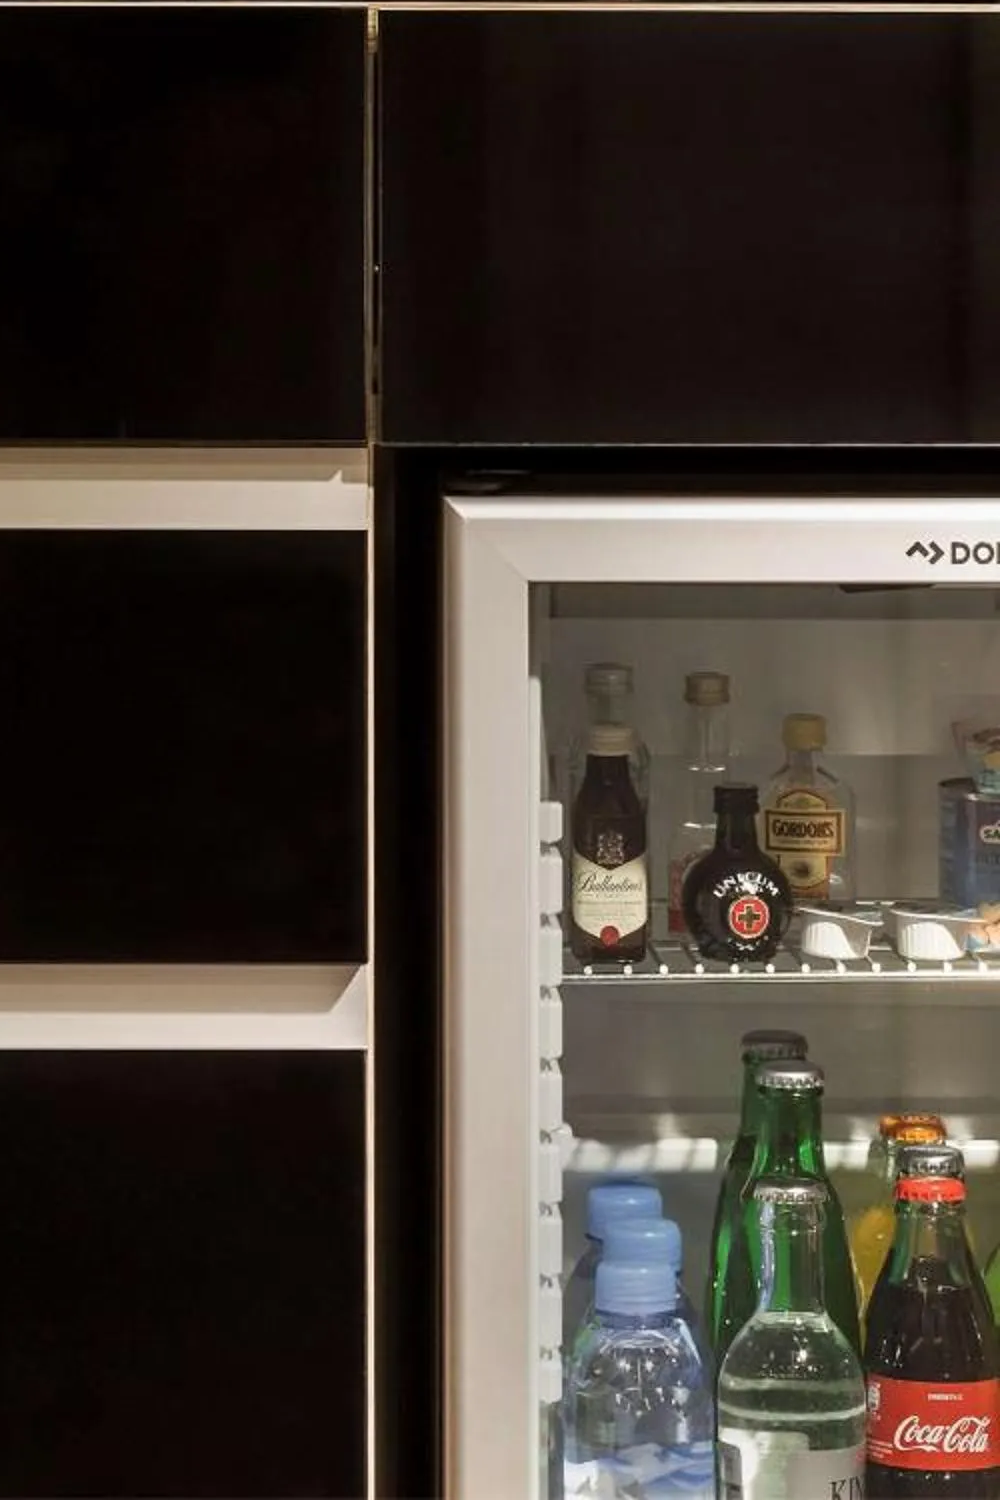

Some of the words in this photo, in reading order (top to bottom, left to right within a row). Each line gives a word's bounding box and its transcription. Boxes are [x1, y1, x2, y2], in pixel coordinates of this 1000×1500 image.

[951, 541, 1000, 565] DO
[713, 871, 780, 898] UNICUM
[893, 1414, 991, 1453] Coca-Cola
